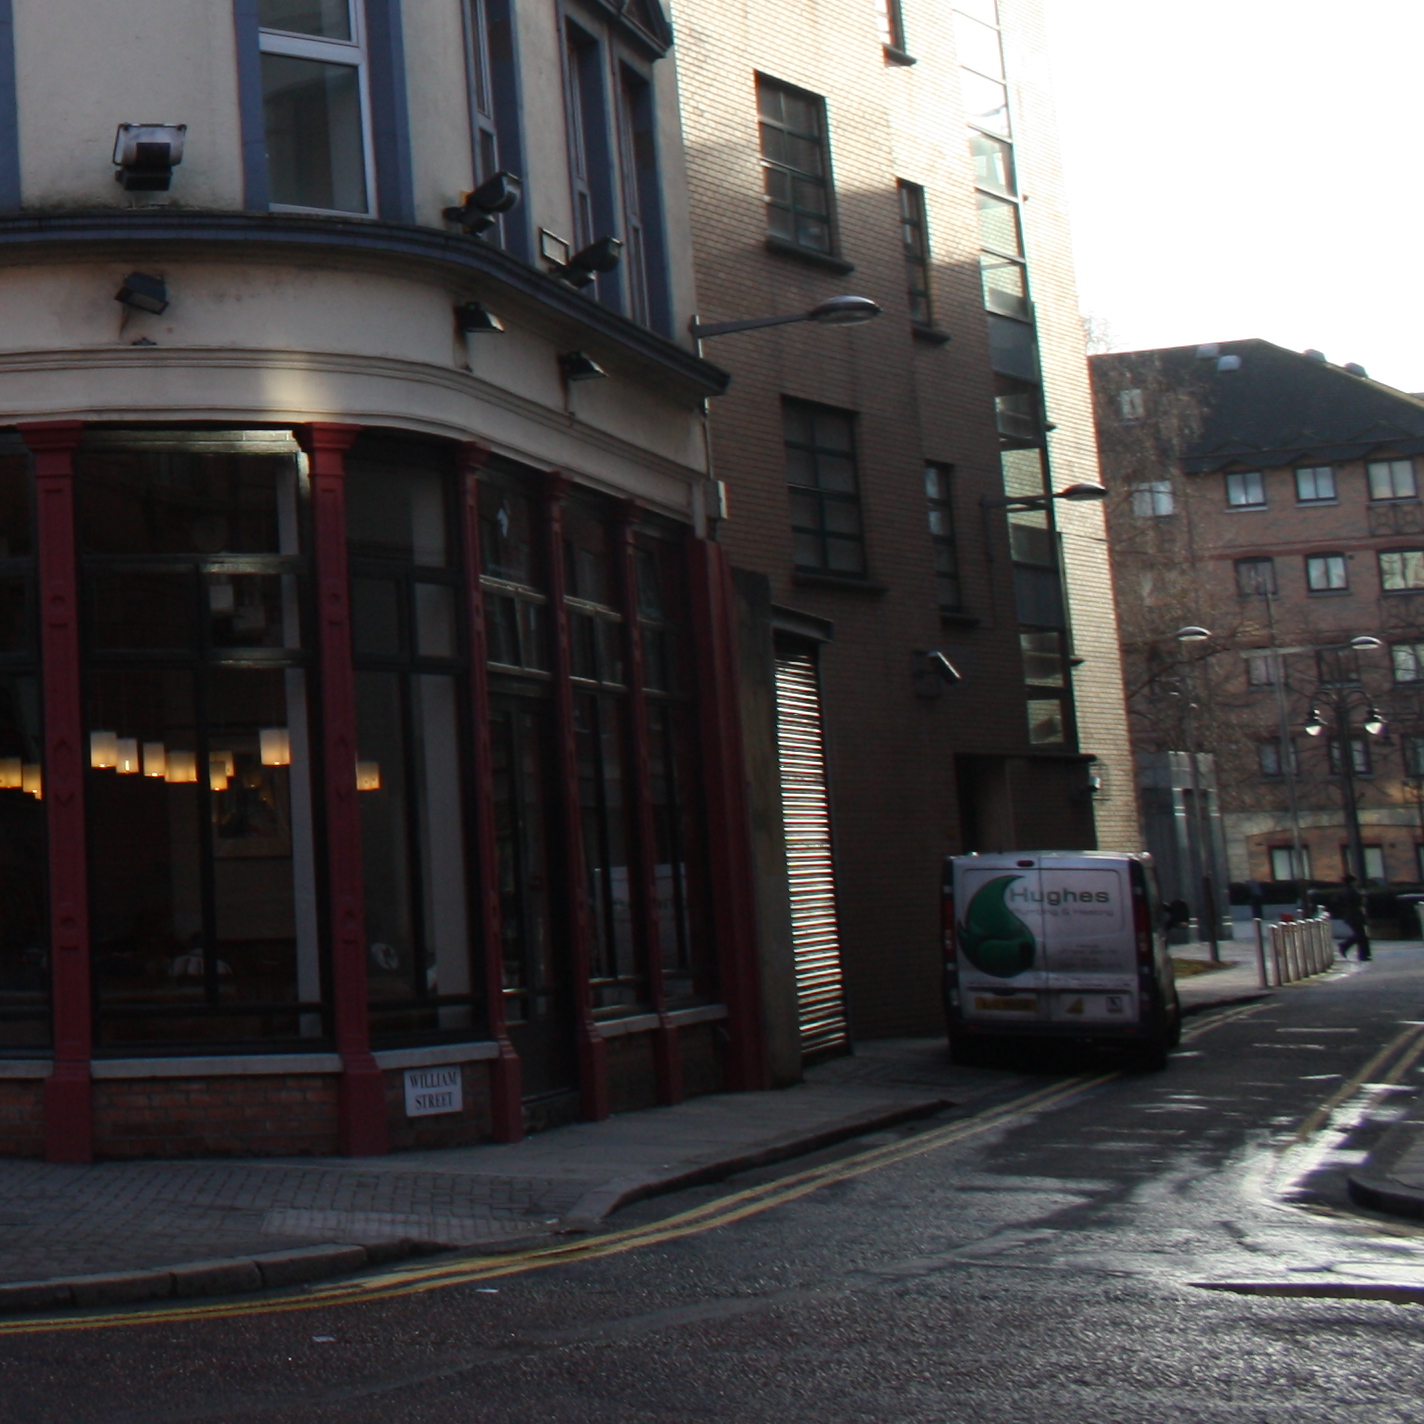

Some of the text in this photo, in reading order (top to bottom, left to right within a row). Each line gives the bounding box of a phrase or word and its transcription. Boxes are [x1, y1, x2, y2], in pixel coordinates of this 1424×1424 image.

[1009, 887, 1110, 906] Hughes
[409, 1071, 458, 1089] WILLIAM
[415, 1091, 453, 1109] STREET
